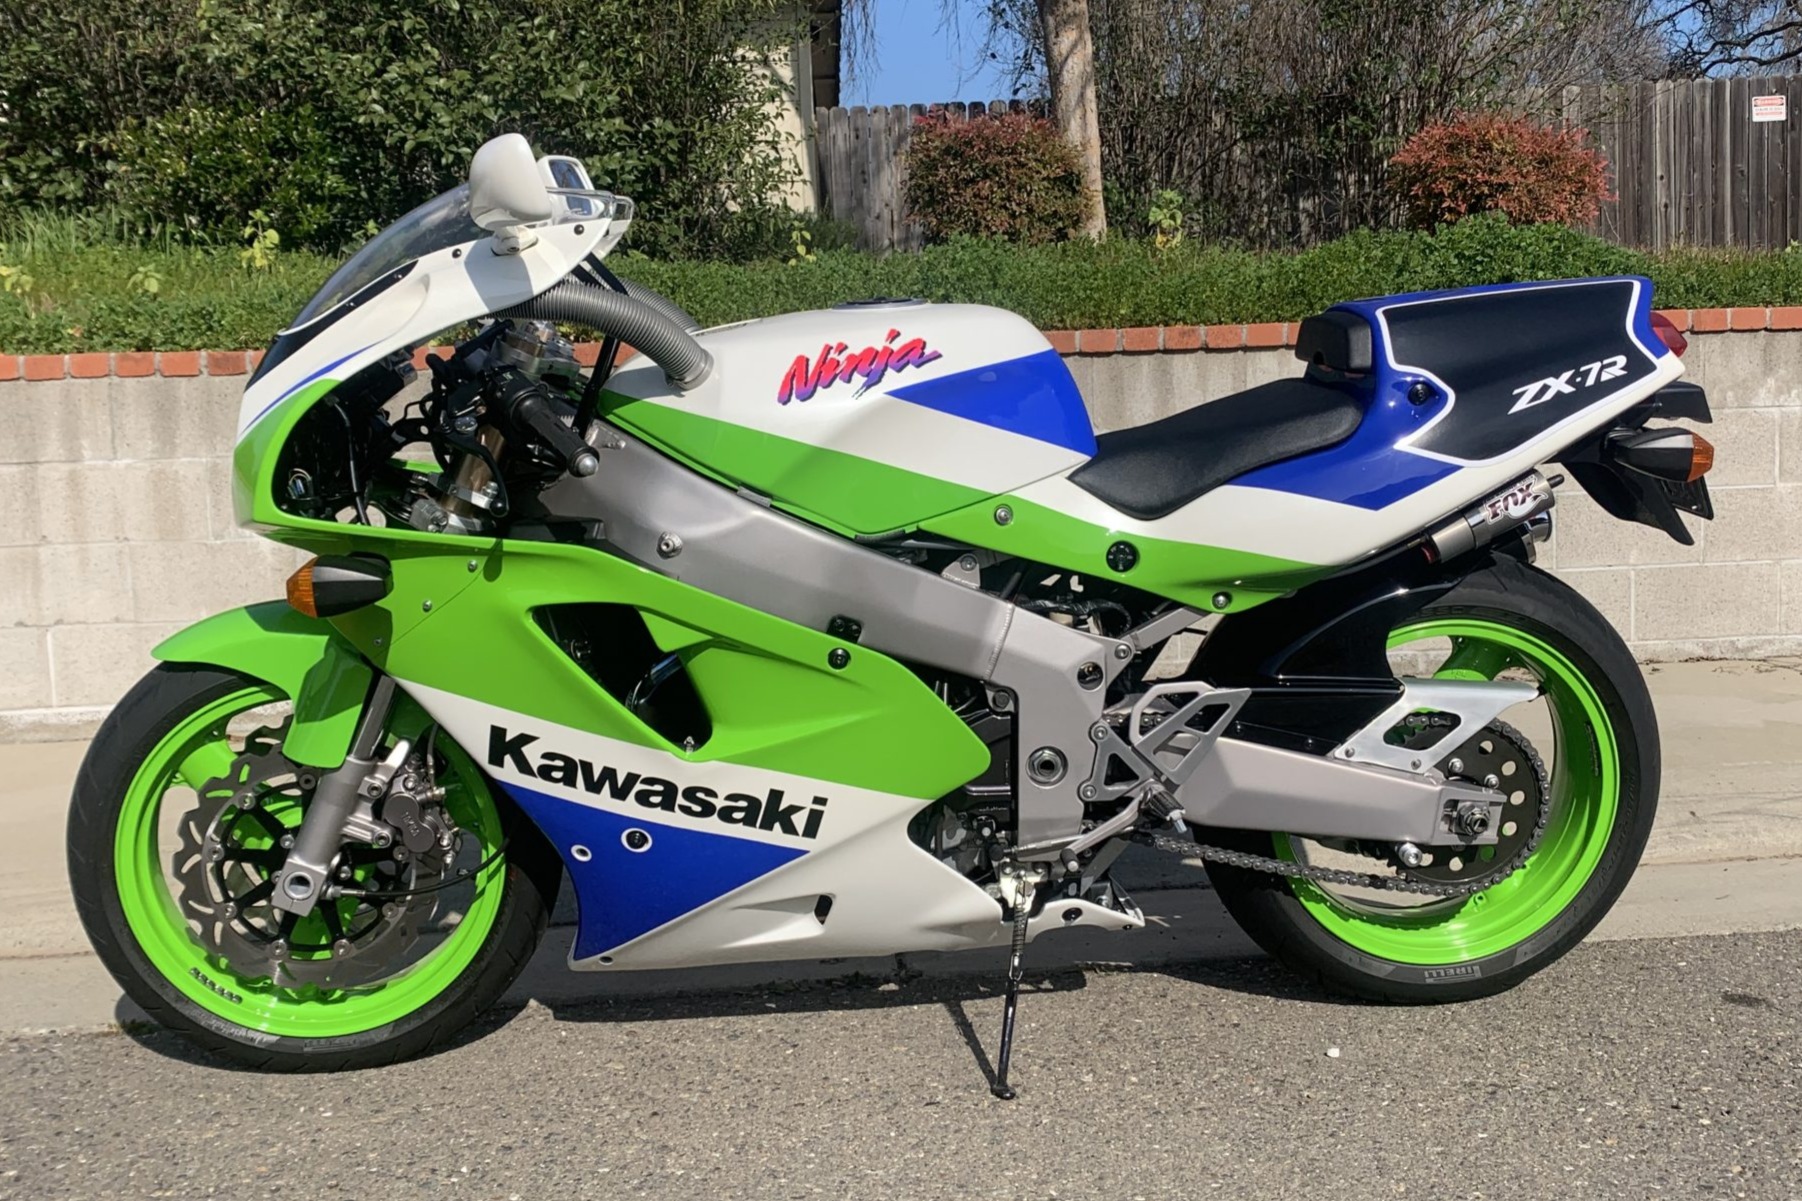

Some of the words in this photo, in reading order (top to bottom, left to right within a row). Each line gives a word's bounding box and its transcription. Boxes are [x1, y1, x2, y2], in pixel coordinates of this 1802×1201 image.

[777, 329, 943, 406] Ninja
[1507, 355, 1628, 415] ZX-7R
[1486, 480, 1538, 520] FOX
[487, 724, 829, 839] Kawasaki
[1424, 965, 1482, 984] PIRELLI
